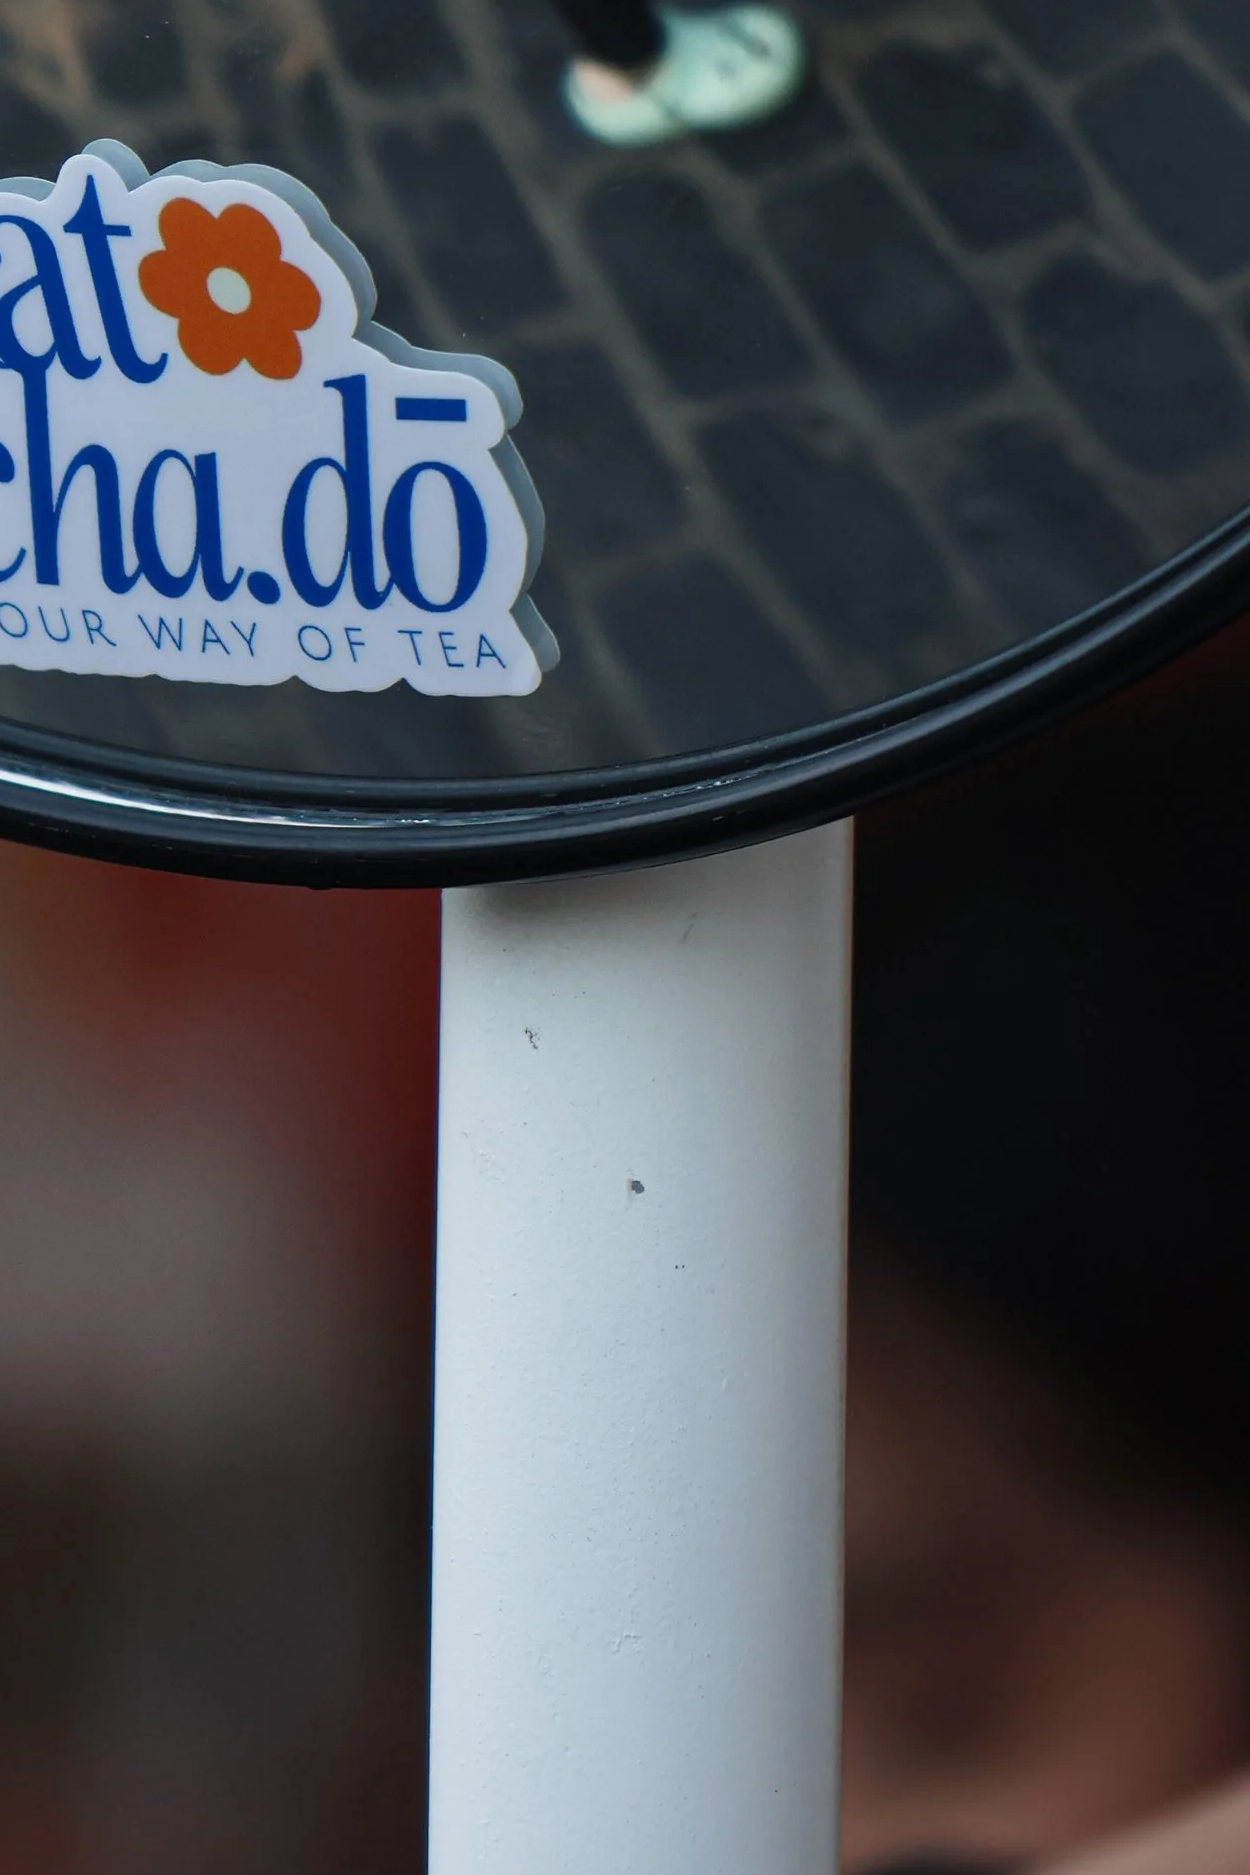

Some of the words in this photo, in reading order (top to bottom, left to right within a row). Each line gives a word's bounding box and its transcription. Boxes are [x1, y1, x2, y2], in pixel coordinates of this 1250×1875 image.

[137, 612, 258, 658] WAY
[297, 623, 363, 664] OF
[397, 628, 507, 671] TEA
